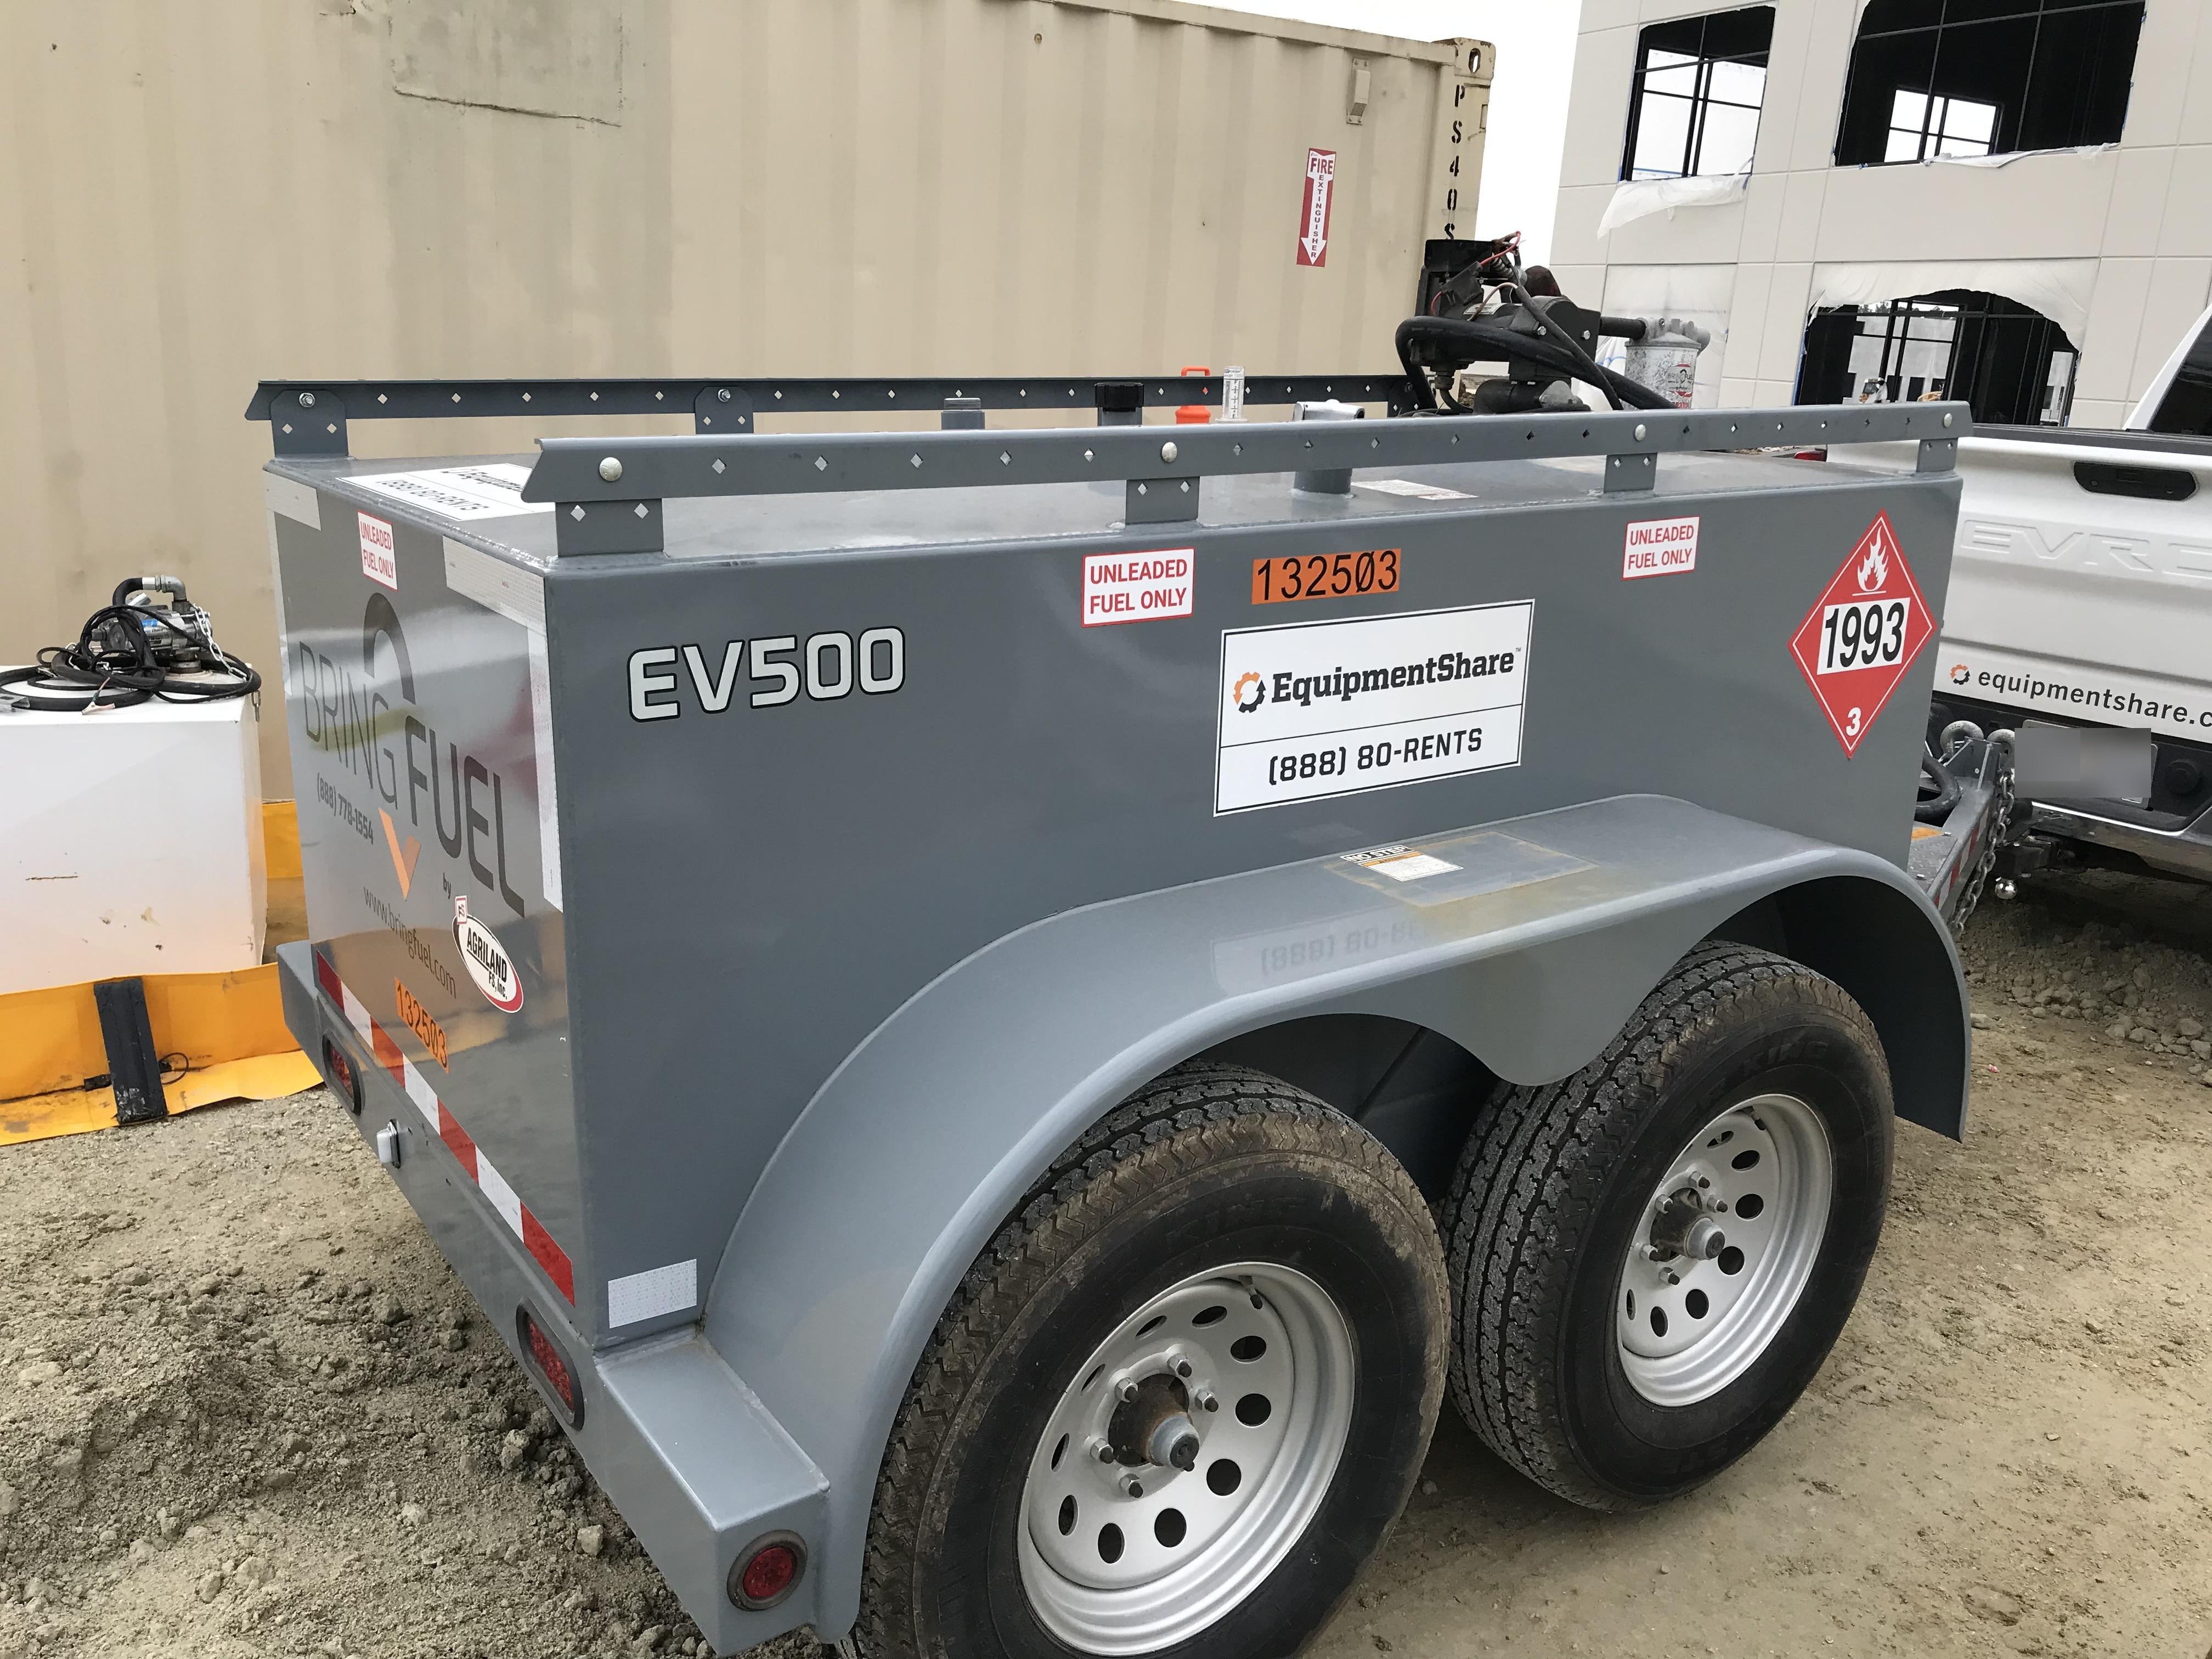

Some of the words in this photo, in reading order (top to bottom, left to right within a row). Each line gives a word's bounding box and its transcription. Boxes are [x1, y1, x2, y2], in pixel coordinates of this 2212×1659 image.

[1310, 157, 1334, 175] FIRE
[1311, 174, 1324, 258] EXTINGUISHER
[409, 490, 489, 511] 80-RENTS
[360, 521, 392, 551] UNLEADED
[1629, 524, 1695, 546] UNLEADED
[363, 549, 378, 572] FUEL
[379, 556, 394, 579] ONLY
[1090, 558, 1188, 585] UNLEADED
[1628, 552, 1657, 570] FUEL
[1661, 548, 1693, 566] ONLY
[1257, 549, 1398, 601] 132503
[1090, 593, 1135, 615] FUEL
[1141, 588, 1187, 610] ONLY
[1825, 601, 1905, 669] 1993
[627, 625, 906, 723] EV500
[1846, 707, 1861, 737] 3
[1268, 746, 1346, 786] (888)
[1357, 727, 1483, 770] 80-RENTS
[317, 772, 337, 817] (888)
[338, 793, 374, 845] 778-1554
[1348, 853, 1369, 862] NO
[1370, 846, 1406, 858] STEP
[443, 872, 452, 900] by
[363, 886, 456, 1000] www.bringfuel.com
[467, 927, 507, 983] AGRILAND
[396, 986, 448, 1070] 132503
